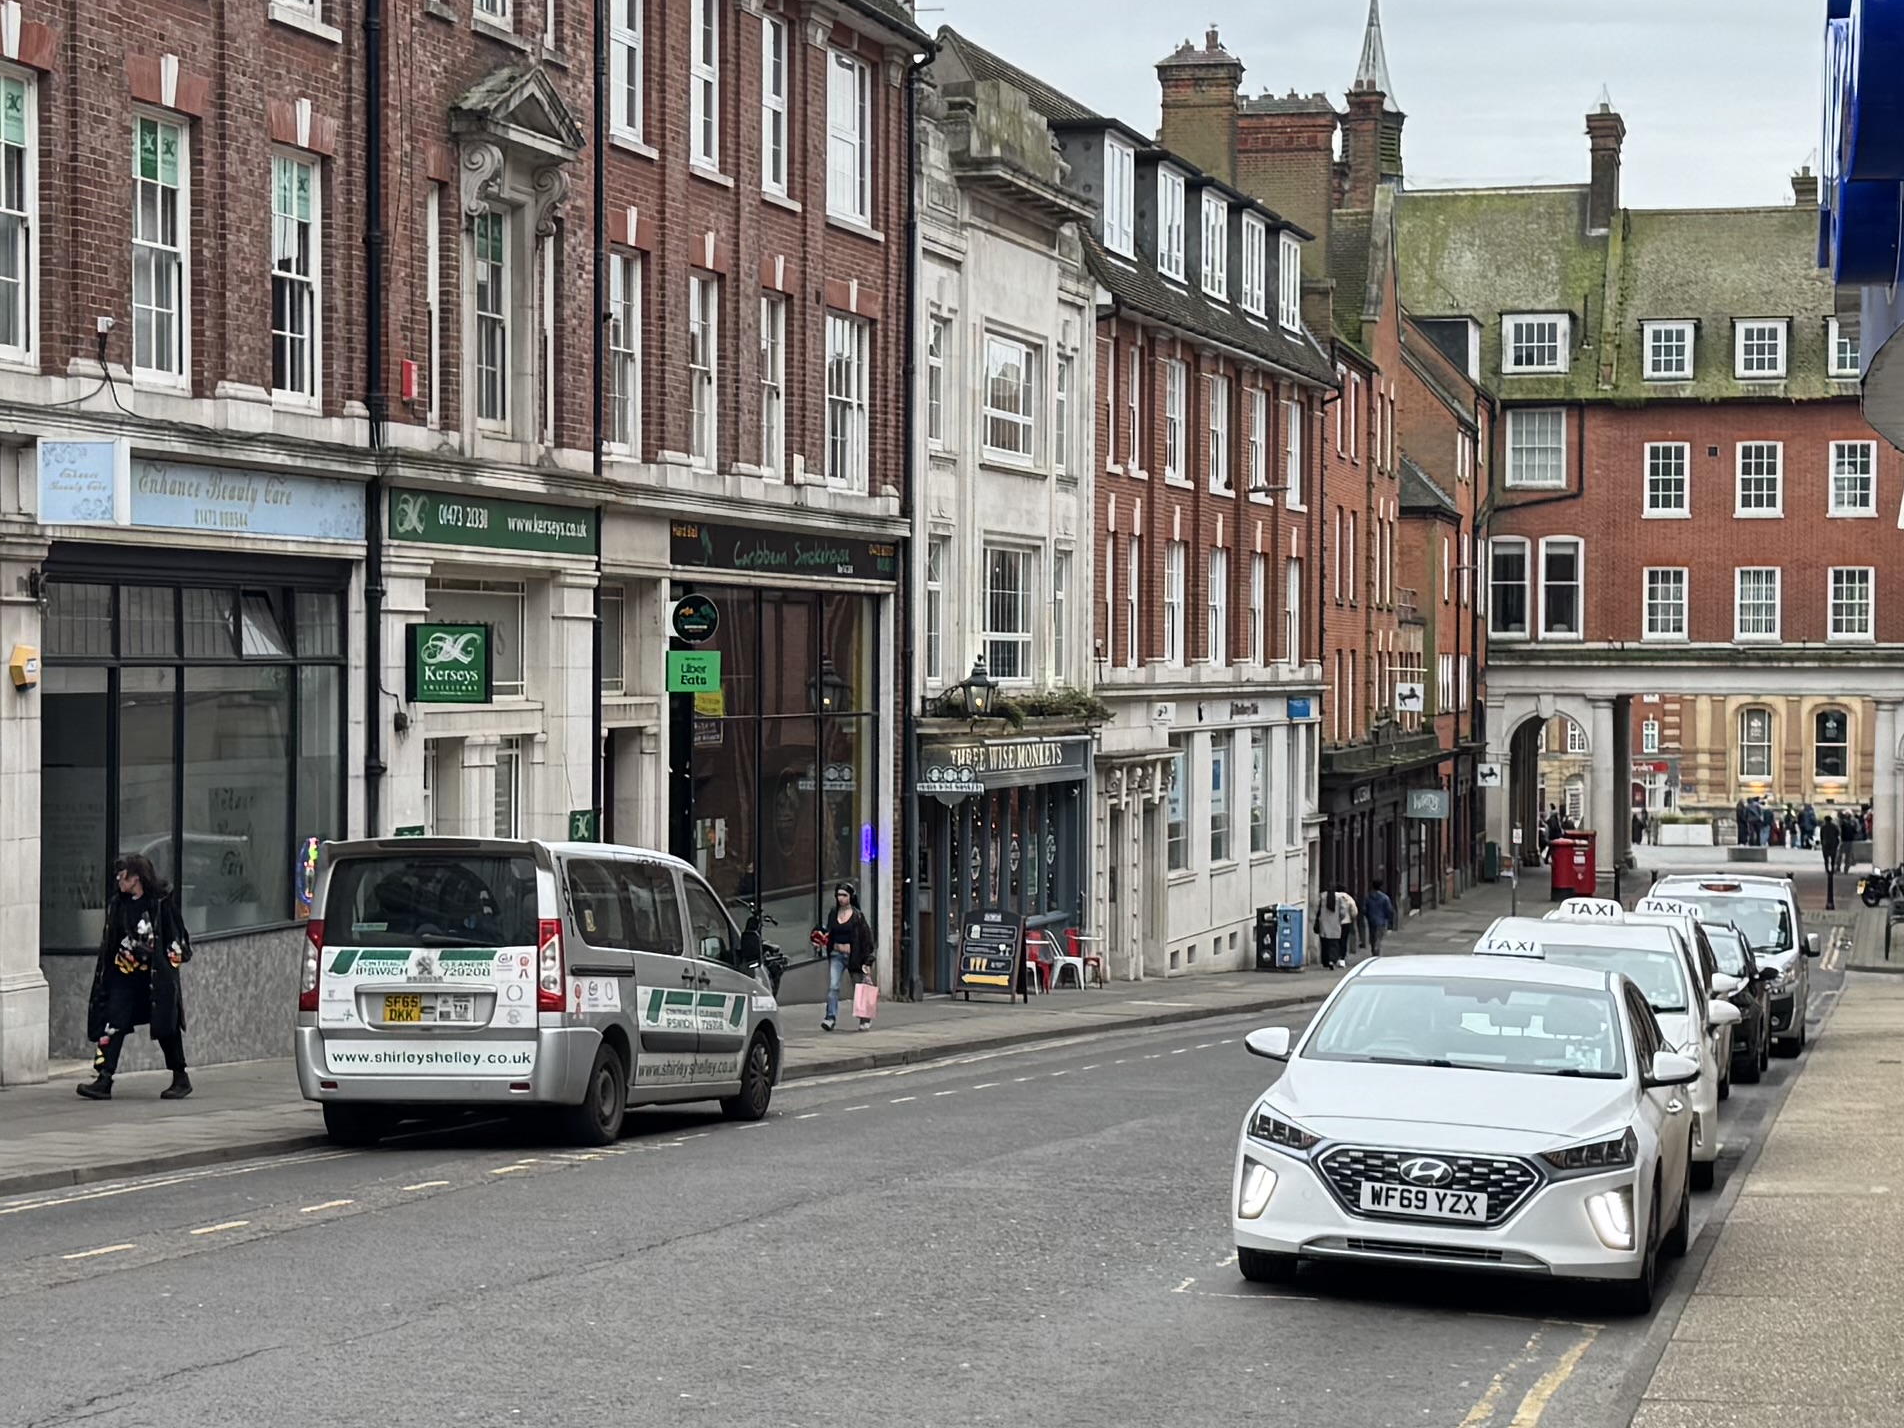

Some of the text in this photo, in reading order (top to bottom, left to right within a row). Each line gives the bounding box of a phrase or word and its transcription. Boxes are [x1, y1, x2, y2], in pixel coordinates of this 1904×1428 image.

[138, 465, 293, 513] Enhance Beauty Care
[424, 666, 478, 684] Kerseys
[681, 663, 707, 674] Uber
[680, 674, 707, 685] Eats
[950, 743, 1063, 772] THREE WISE MONKEYS
[1568, 902, 1614, 916] TAXI
[1646, 900, 1683, 915] TAXI
[1488, 939, 1535, 952] TAXI
[389, 1009, 414, 1021] DKK
[332, 1051, 532, 1066] www.shirleyshelley.co.uk
[1371, 1184, 1478, 1215] WF69 YZX
